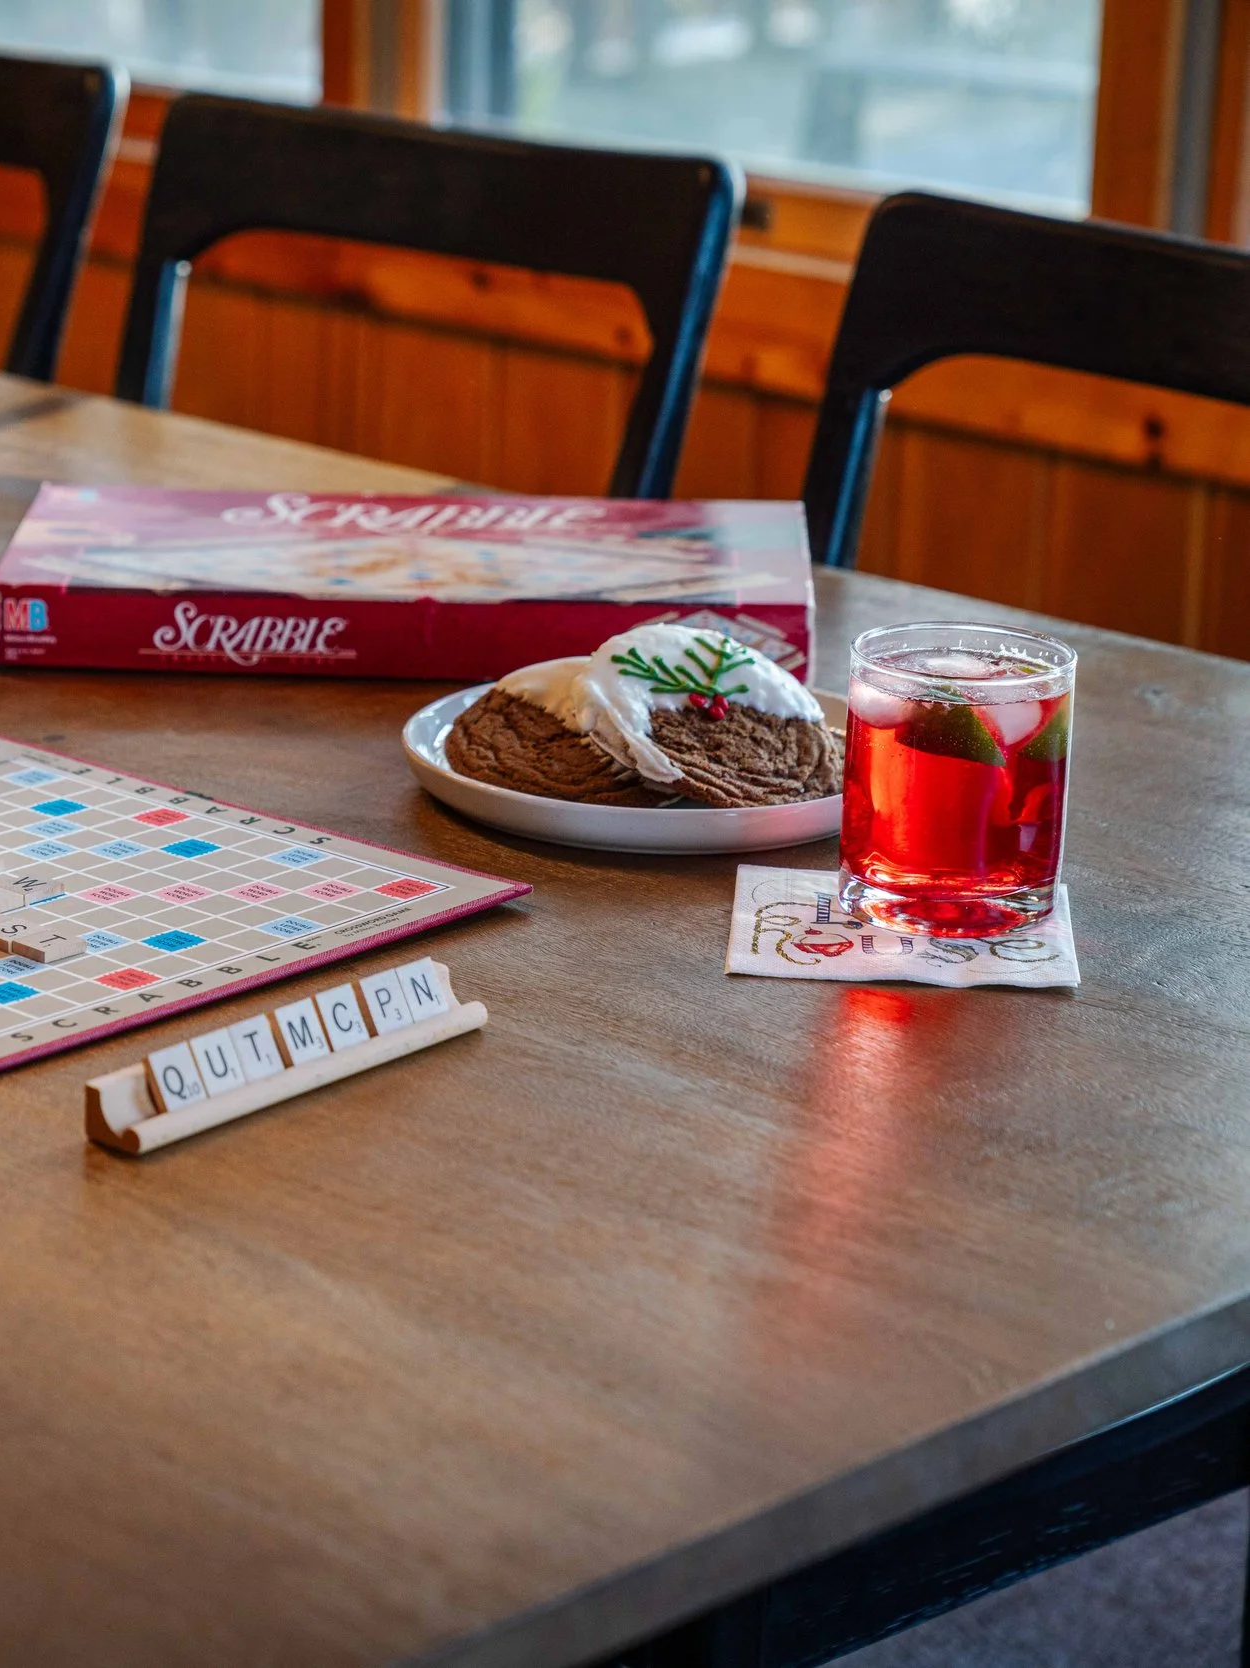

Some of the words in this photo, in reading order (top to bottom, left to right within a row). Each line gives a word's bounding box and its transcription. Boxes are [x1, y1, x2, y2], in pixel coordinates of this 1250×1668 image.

[4, 598, 48, 631] MB
[153, 600, 347, 666] SCRABBLE
[105, 887, 129, 896] DOUBLE
[174, 889, 193, 897] WORD
[180, 886, 204, 895] DOUBLE
[247, 888, 267, 896] WORD
[253, 885, 278, 894] DOUBLE
[313, 888, 334, 897] SCORE
[328, 884, 353, 893] DOUBLE
[90, 892, 110, 900] SCORE
[99, 890, 118, 898] WORD
[164, 891, 185, 899] SCORE
[238, 890, 259, 898] SCORE
[272, 925, 293, 933] SCORE
[280, 923, 302, 931] LETTER
[287, 920, 313, 930] DOUBLE
[88, 937, 108, 946] LETTER
[95, 934, 120, 944] DOUBLE
[3, 962, 24, 971] LETTER
[11, 959, 36, 970] DOUBLE
[11, 941, 317, 1043] SCRABBLE
